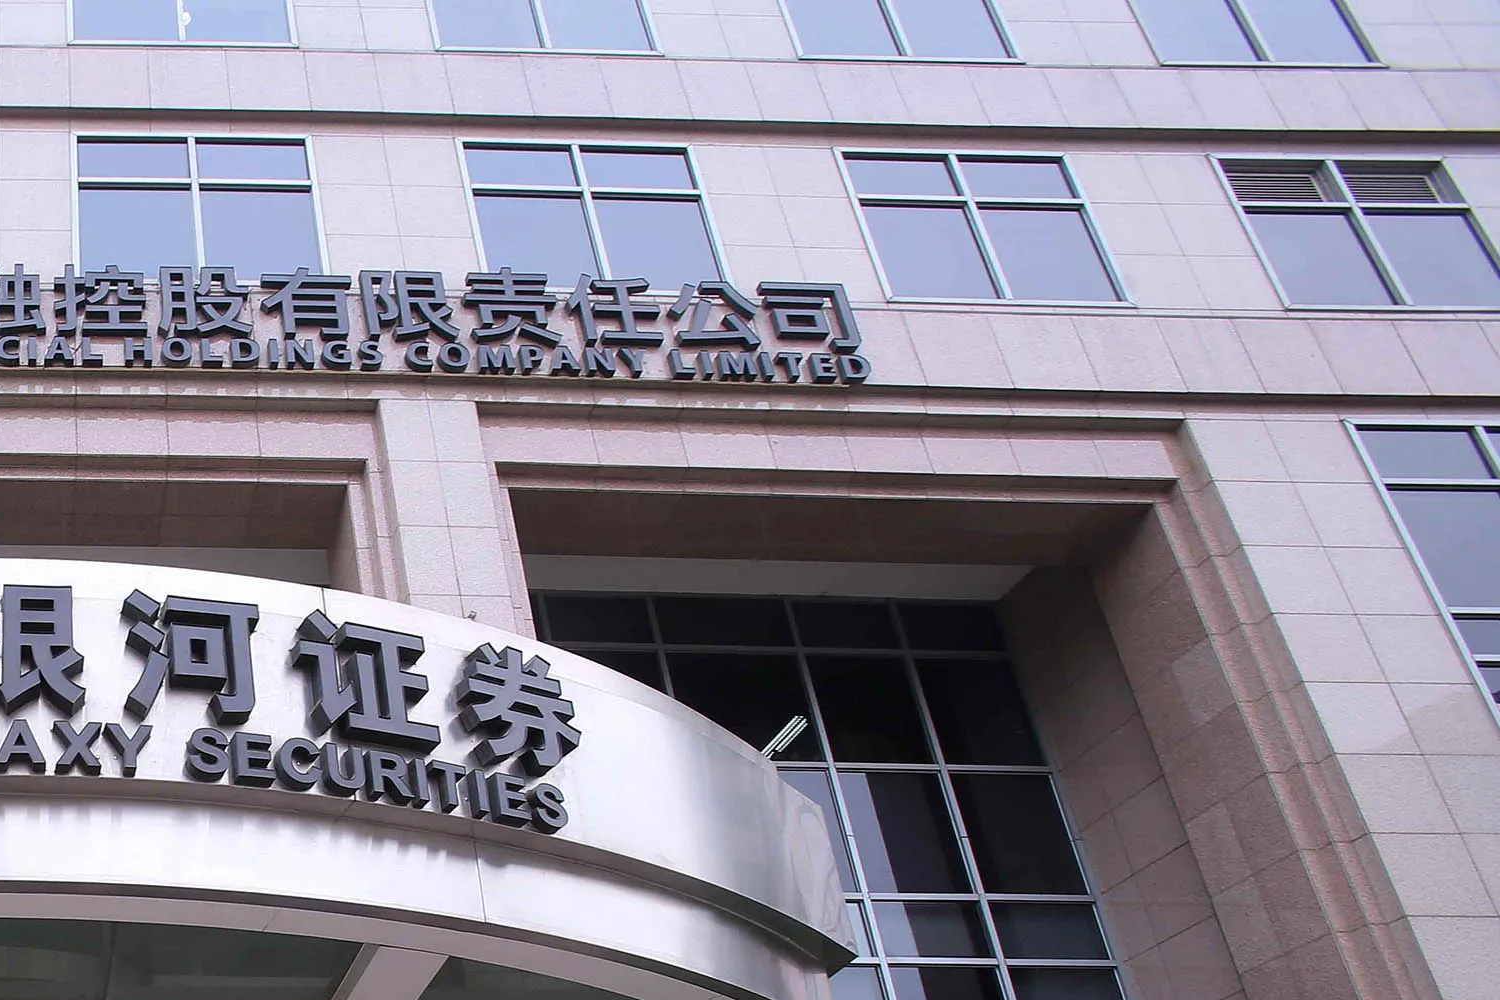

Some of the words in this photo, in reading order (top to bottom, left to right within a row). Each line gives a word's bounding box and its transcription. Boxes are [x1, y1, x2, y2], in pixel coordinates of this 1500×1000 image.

[124, 336, 383, 372] HOLDINGS
[405, 340, 648, 380] COMPANY
[668, 347, 871, 384] LIMITED
[185, 726, 569, 835] SECURITIES
